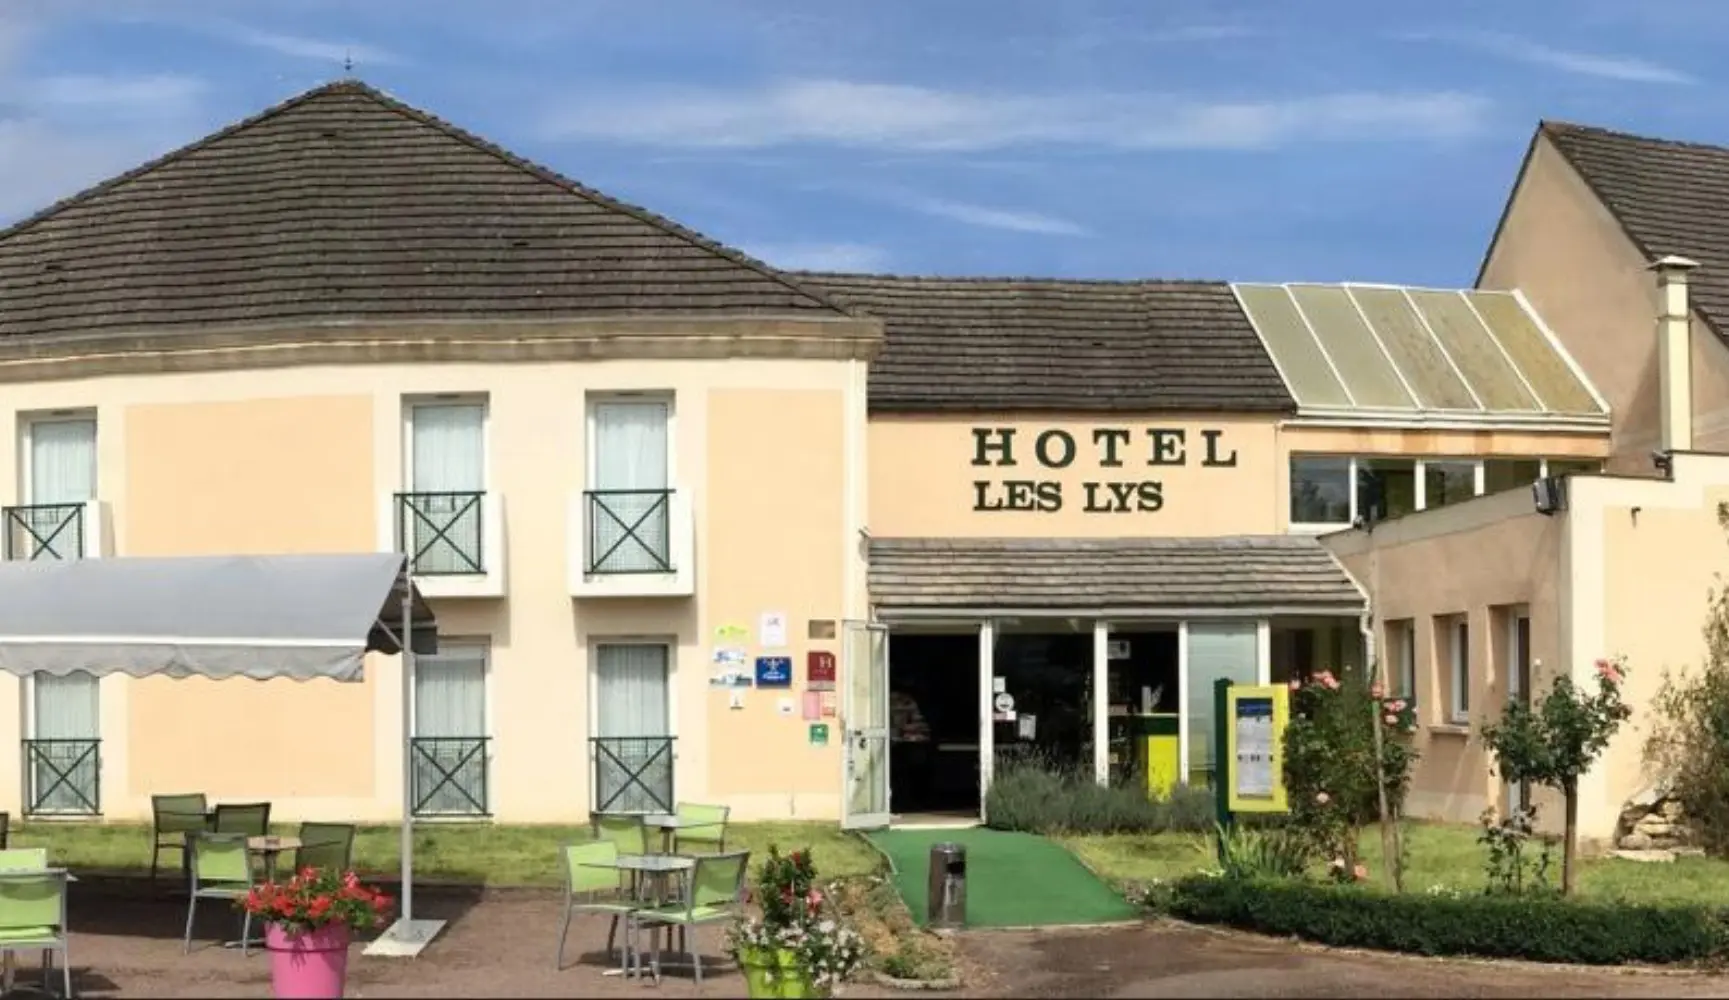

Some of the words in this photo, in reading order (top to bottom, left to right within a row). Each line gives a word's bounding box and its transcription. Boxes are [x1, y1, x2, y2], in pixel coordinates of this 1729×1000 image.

[971, 428, 1237, 467] HOTEL
[973, 481, 1062, 512] LES
[1083, 481, 1163, 512] LYS
